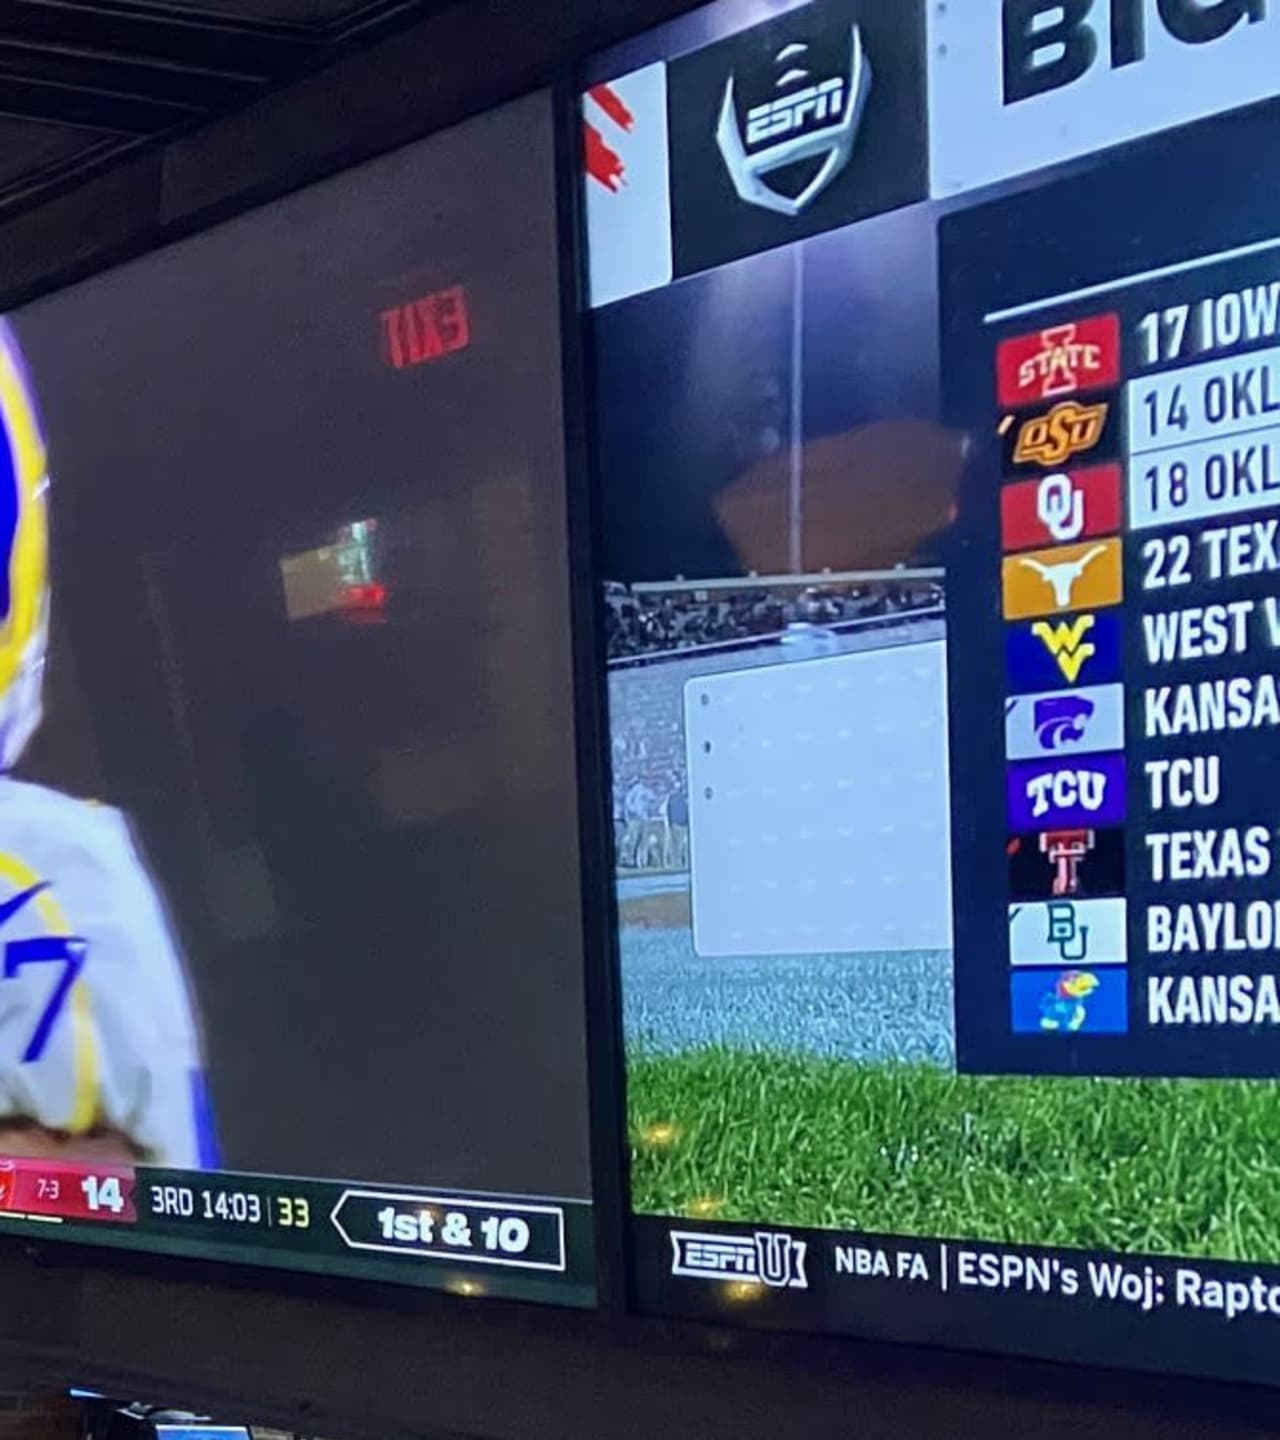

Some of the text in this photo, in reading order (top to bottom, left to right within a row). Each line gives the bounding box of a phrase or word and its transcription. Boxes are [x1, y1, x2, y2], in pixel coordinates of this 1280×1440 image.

[747, 77, 844, 145] ESPN
[1138, 281, 1280, 364] 17 IOW
[1144, 365, 1280, 437] 14 OKL
[1144, 444, 1280, 512] 18 OKL
[1143, 535, 1191, 590] 22
[1143, 600, 1254, 664] WEST
[1145, 674, 1280, 737] KANSA
[1027, 770, 1106, 818] TCU
[1145, 755, 1219, 809] TCU
[1145, 826, 1271, 882] TEXAS
[1147, 901, 1280, 952] BAYLO
[1148, 974, 1280, 1024] KANSA
[36, 1176, 124, 1213] 7-3 14
[150, 1186, 310, 1228] 3RD 14:03 33
[378, 1207, 530, 1253] 1st & 10
[835, 1246, 930, 1281] NBA FA
[958, 1252, 1079, 1295] ESPN's
[1088, 1261, 1165, 1310] Woj:
